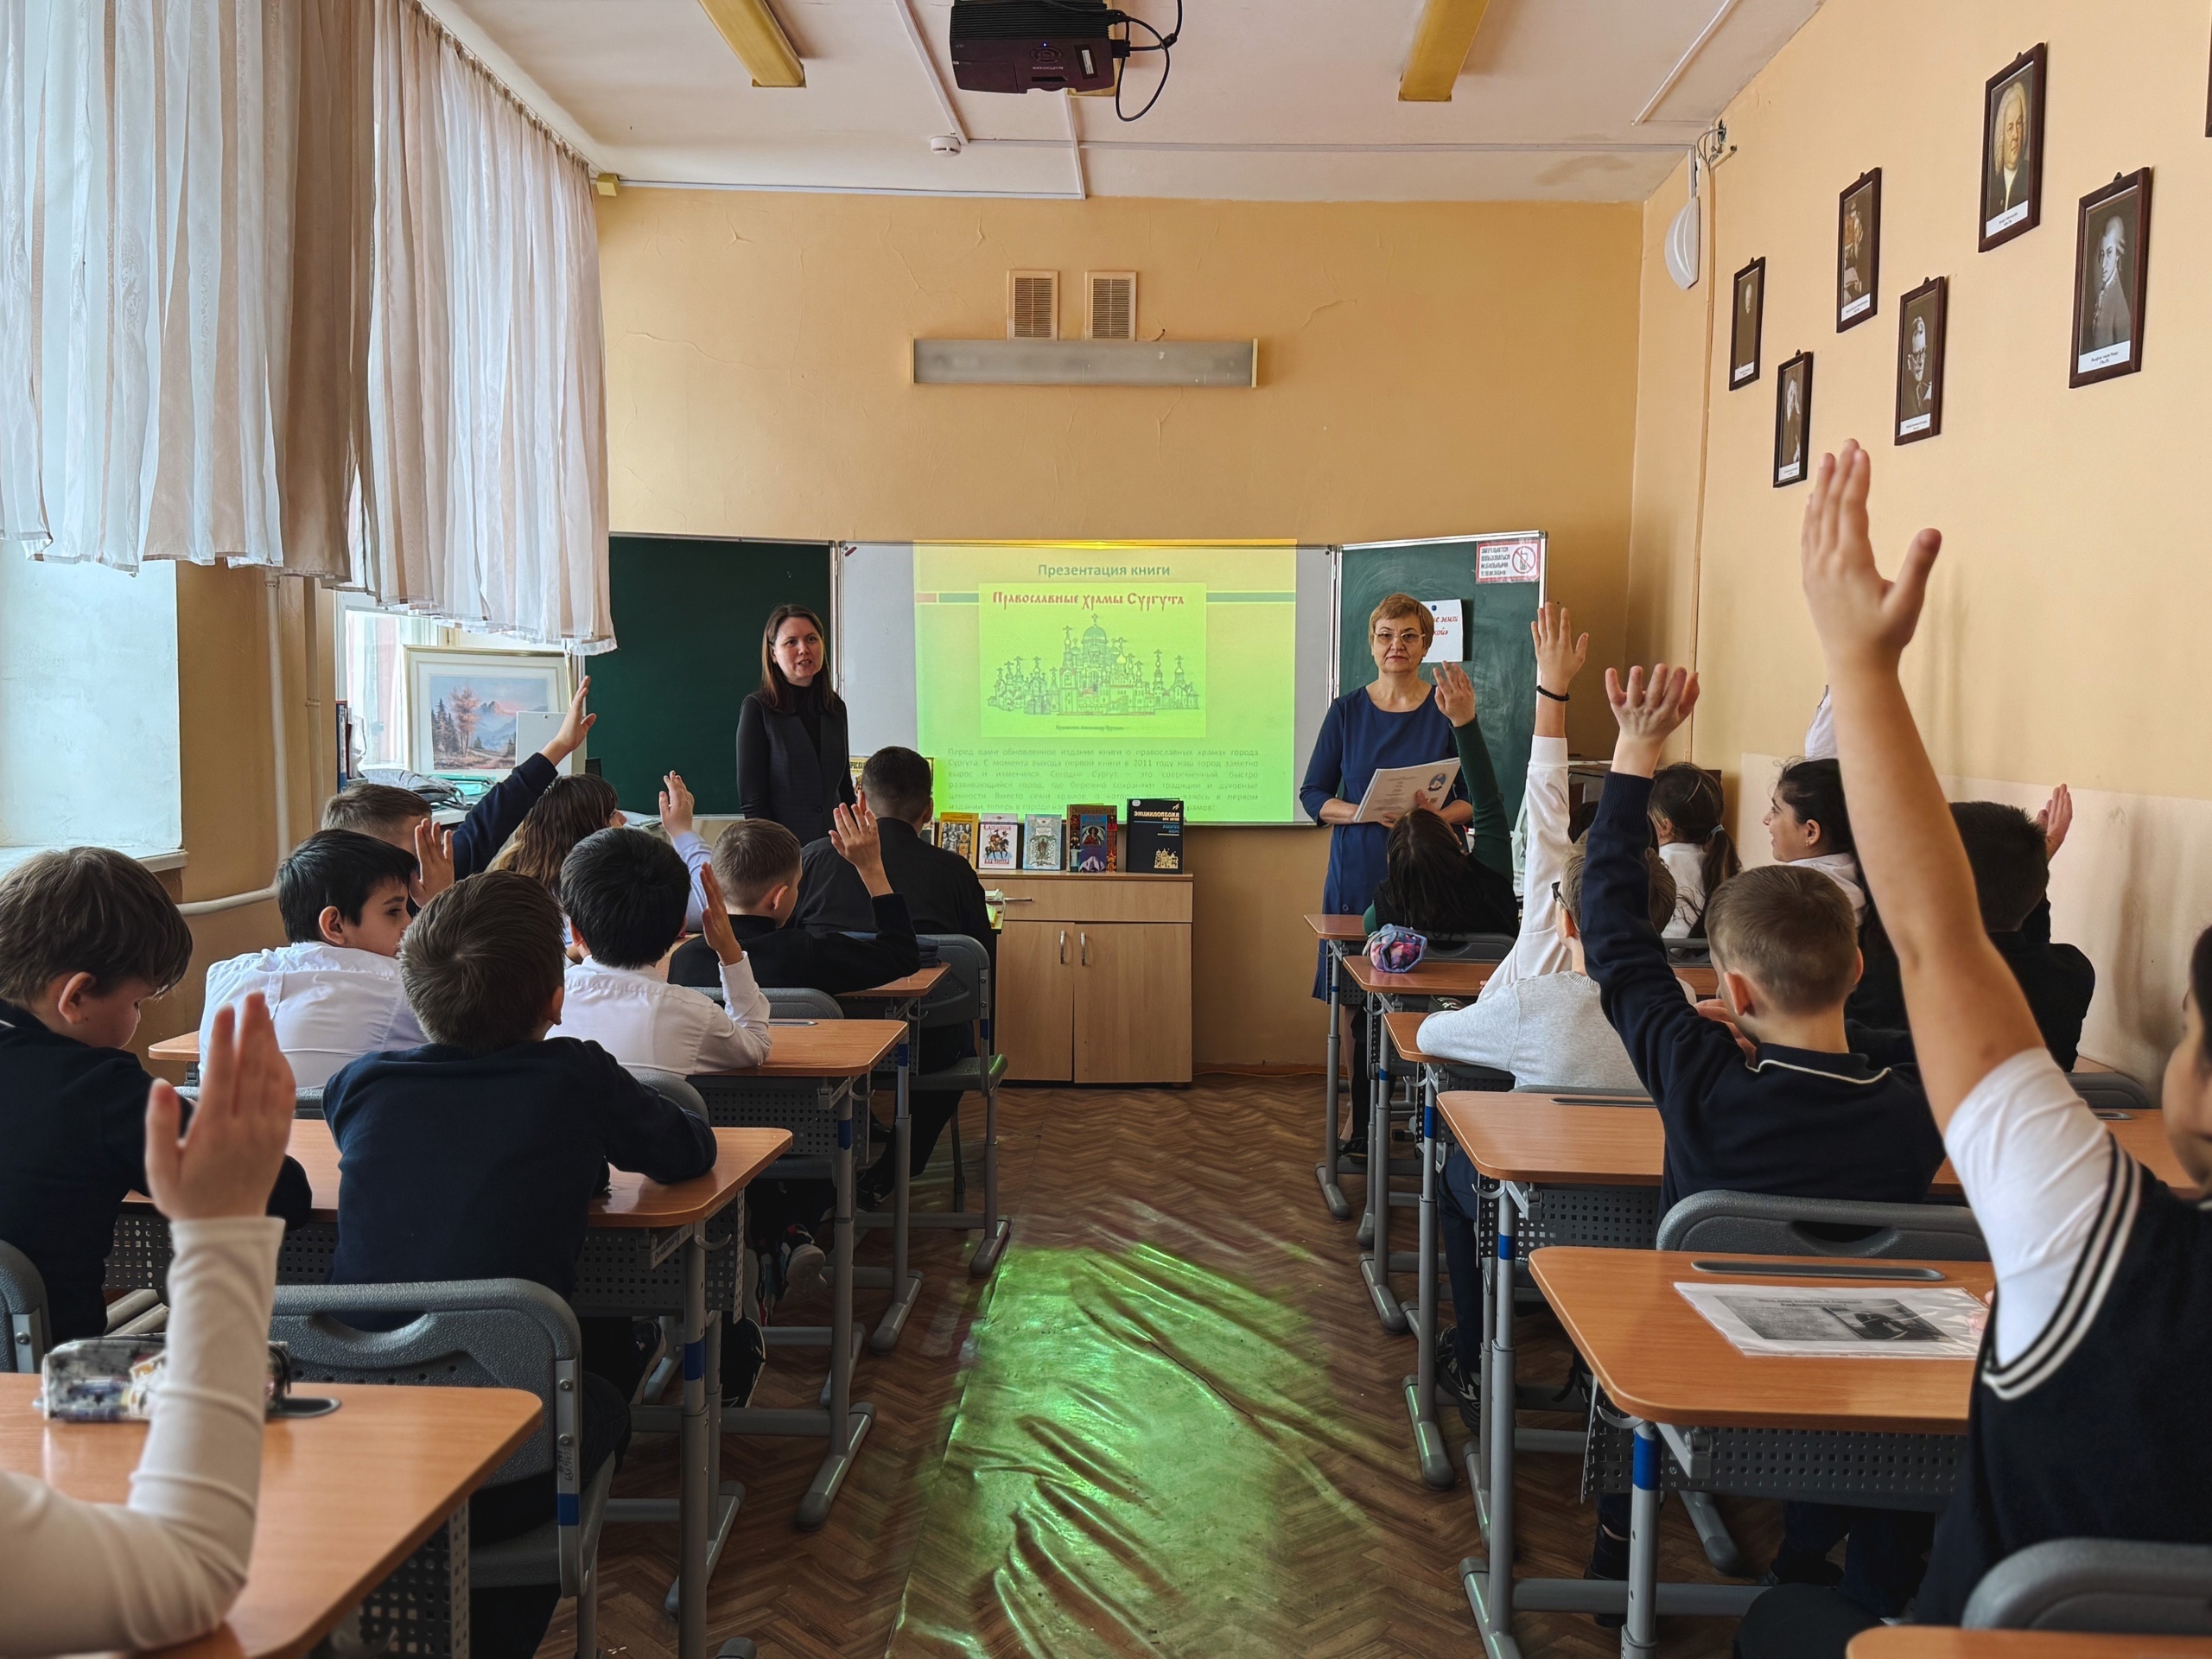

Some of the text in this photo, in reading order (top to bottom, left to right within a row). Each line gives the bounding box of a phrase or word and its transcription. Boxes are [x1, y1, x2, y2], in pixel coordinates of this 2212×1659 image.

[1038, 564, 1171, 578] Презентация книги
[992, 591, 1185, 612] Православные храмы Сургута
[948, 748, 974, 757] Перед
[1065, 760, 1095, 768] первой
[1156, 760, 1173, 769] году
[948, 771, 974, 779] вырос
[1051, 770, 1083, 779] Сегодня
[1091, 771, 1117, 779] Сургут
[1230, 771, 1259, 779] быстро
[1227, 793, 1259, 802] первом
[987, 804, 1014, 812] теперь
[1022, 804, 1051, 812] городе
